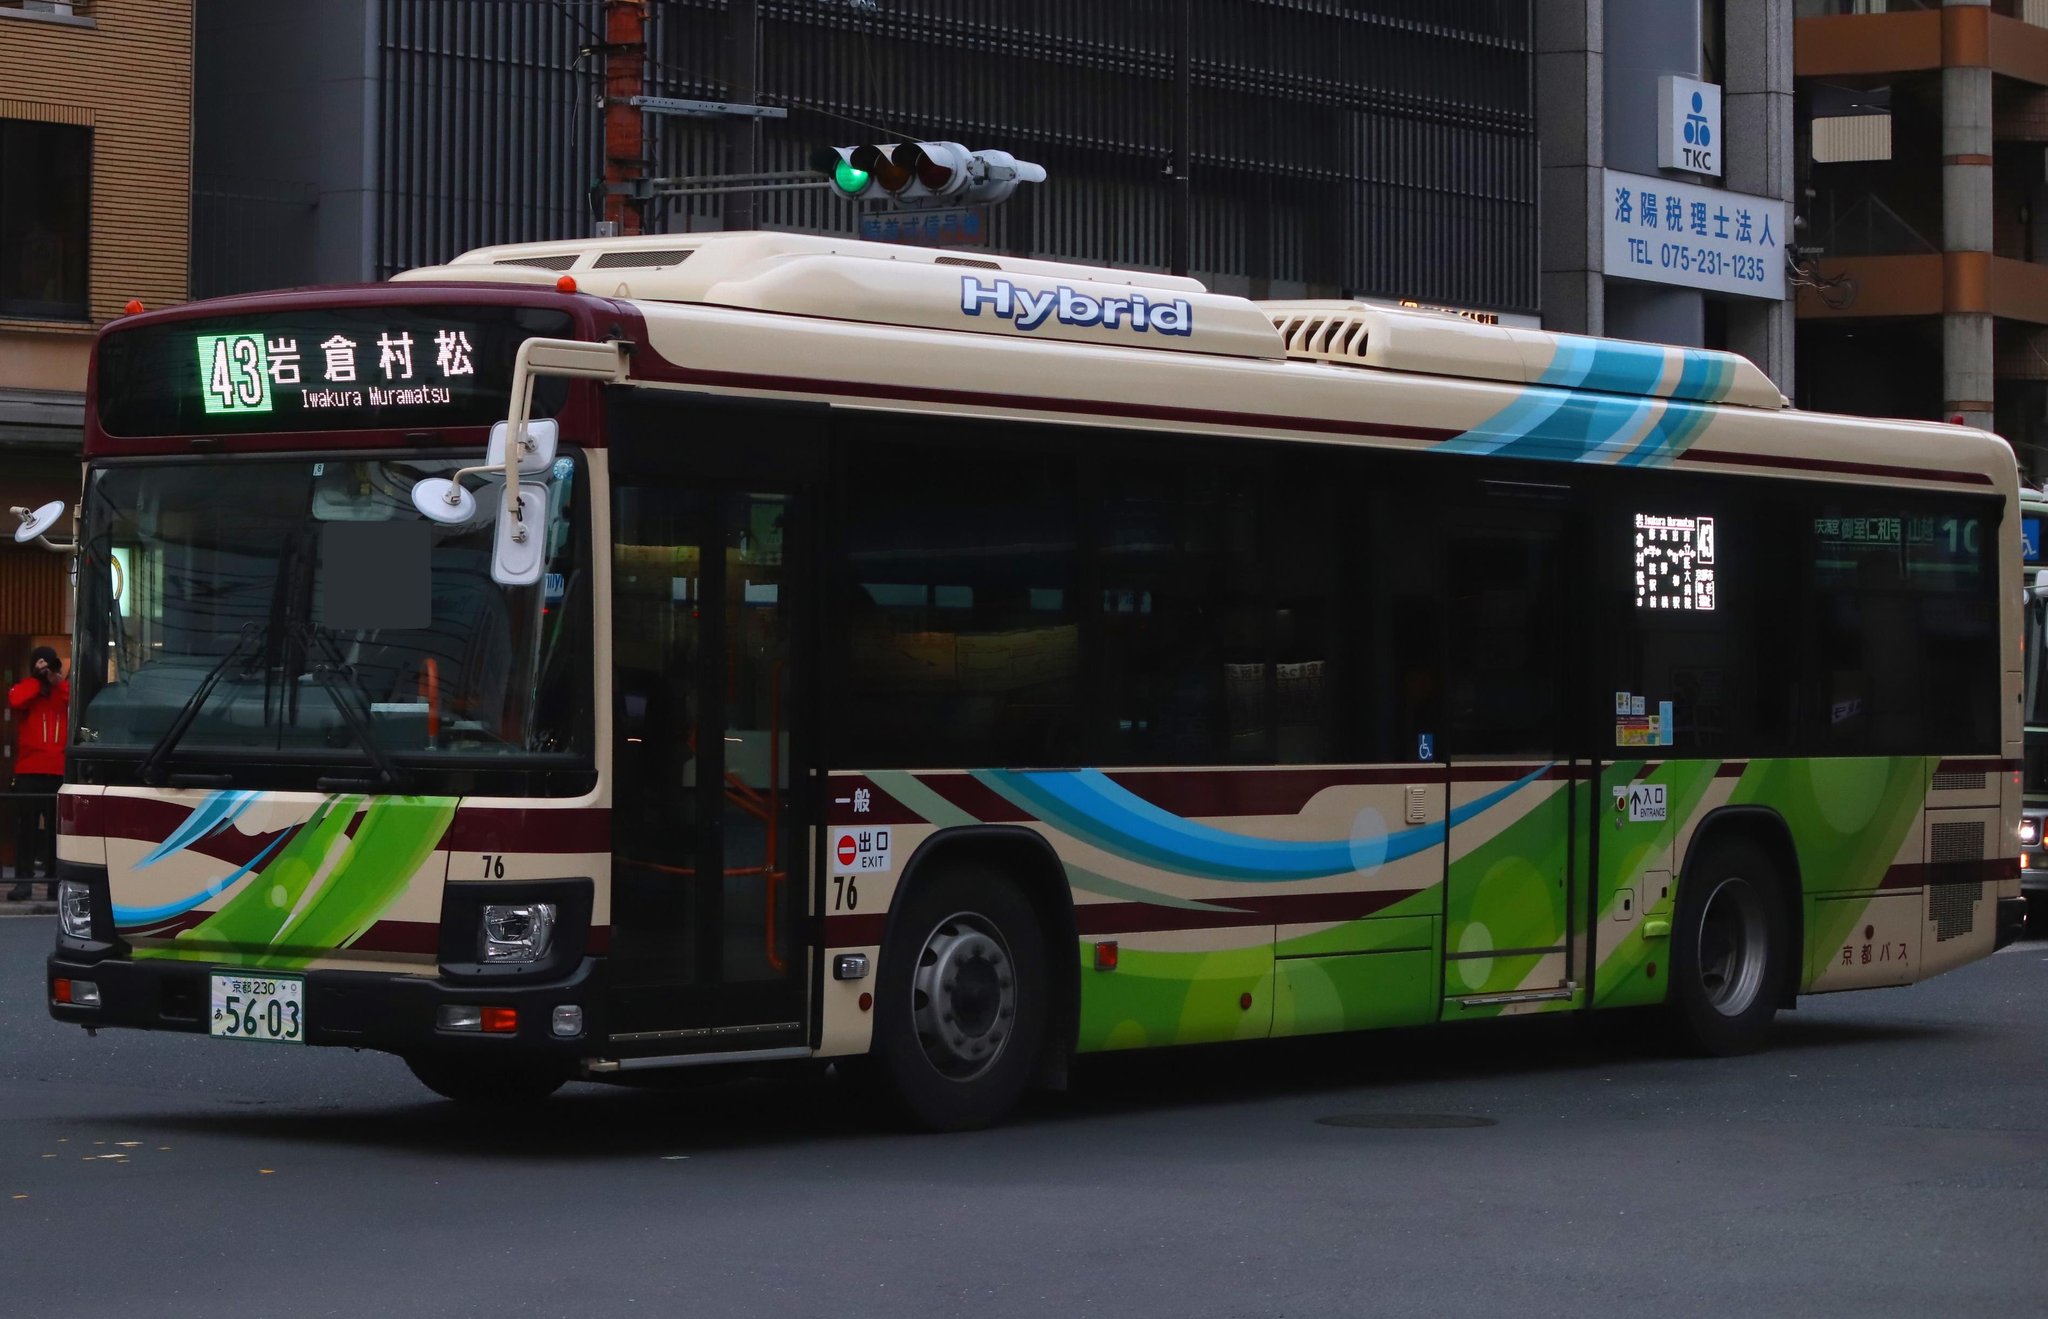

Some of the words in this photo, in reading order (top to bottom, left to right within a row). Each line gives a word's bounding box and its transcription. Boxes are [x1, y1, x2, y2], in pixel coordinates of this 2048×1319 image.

[1683, 148, 1711, 171] TKC
[1614, 187, 1775, 247] 洛陽税理士法人
[1628, 238, 1652, 265] TEL
[1661, 243, 1765, 282] 075-231-1235
[961, 276, 1192, 337] Hybrid
[209, 336, 262, 408] 43
[267, 330, 474, 384] 岩倉村松
[302, 388, 362, 409] Iwakura
[369, 384, 450, 406] Muramatsu
[835, 788, 870, 812] 一般
[1643, 788, 1663, 804] 入口
[1640, 807, 1666, 818] ENTRANCE
[859, 831, 888, 852] 出口
[482, 855, 505, 879] 76
[862, 855, 884, 868] EXIT
[834, 876, 858, 910] 76
[1841, 942, 1908, 966] 京都バス
[226, 995, 300, 1038] 56-03
